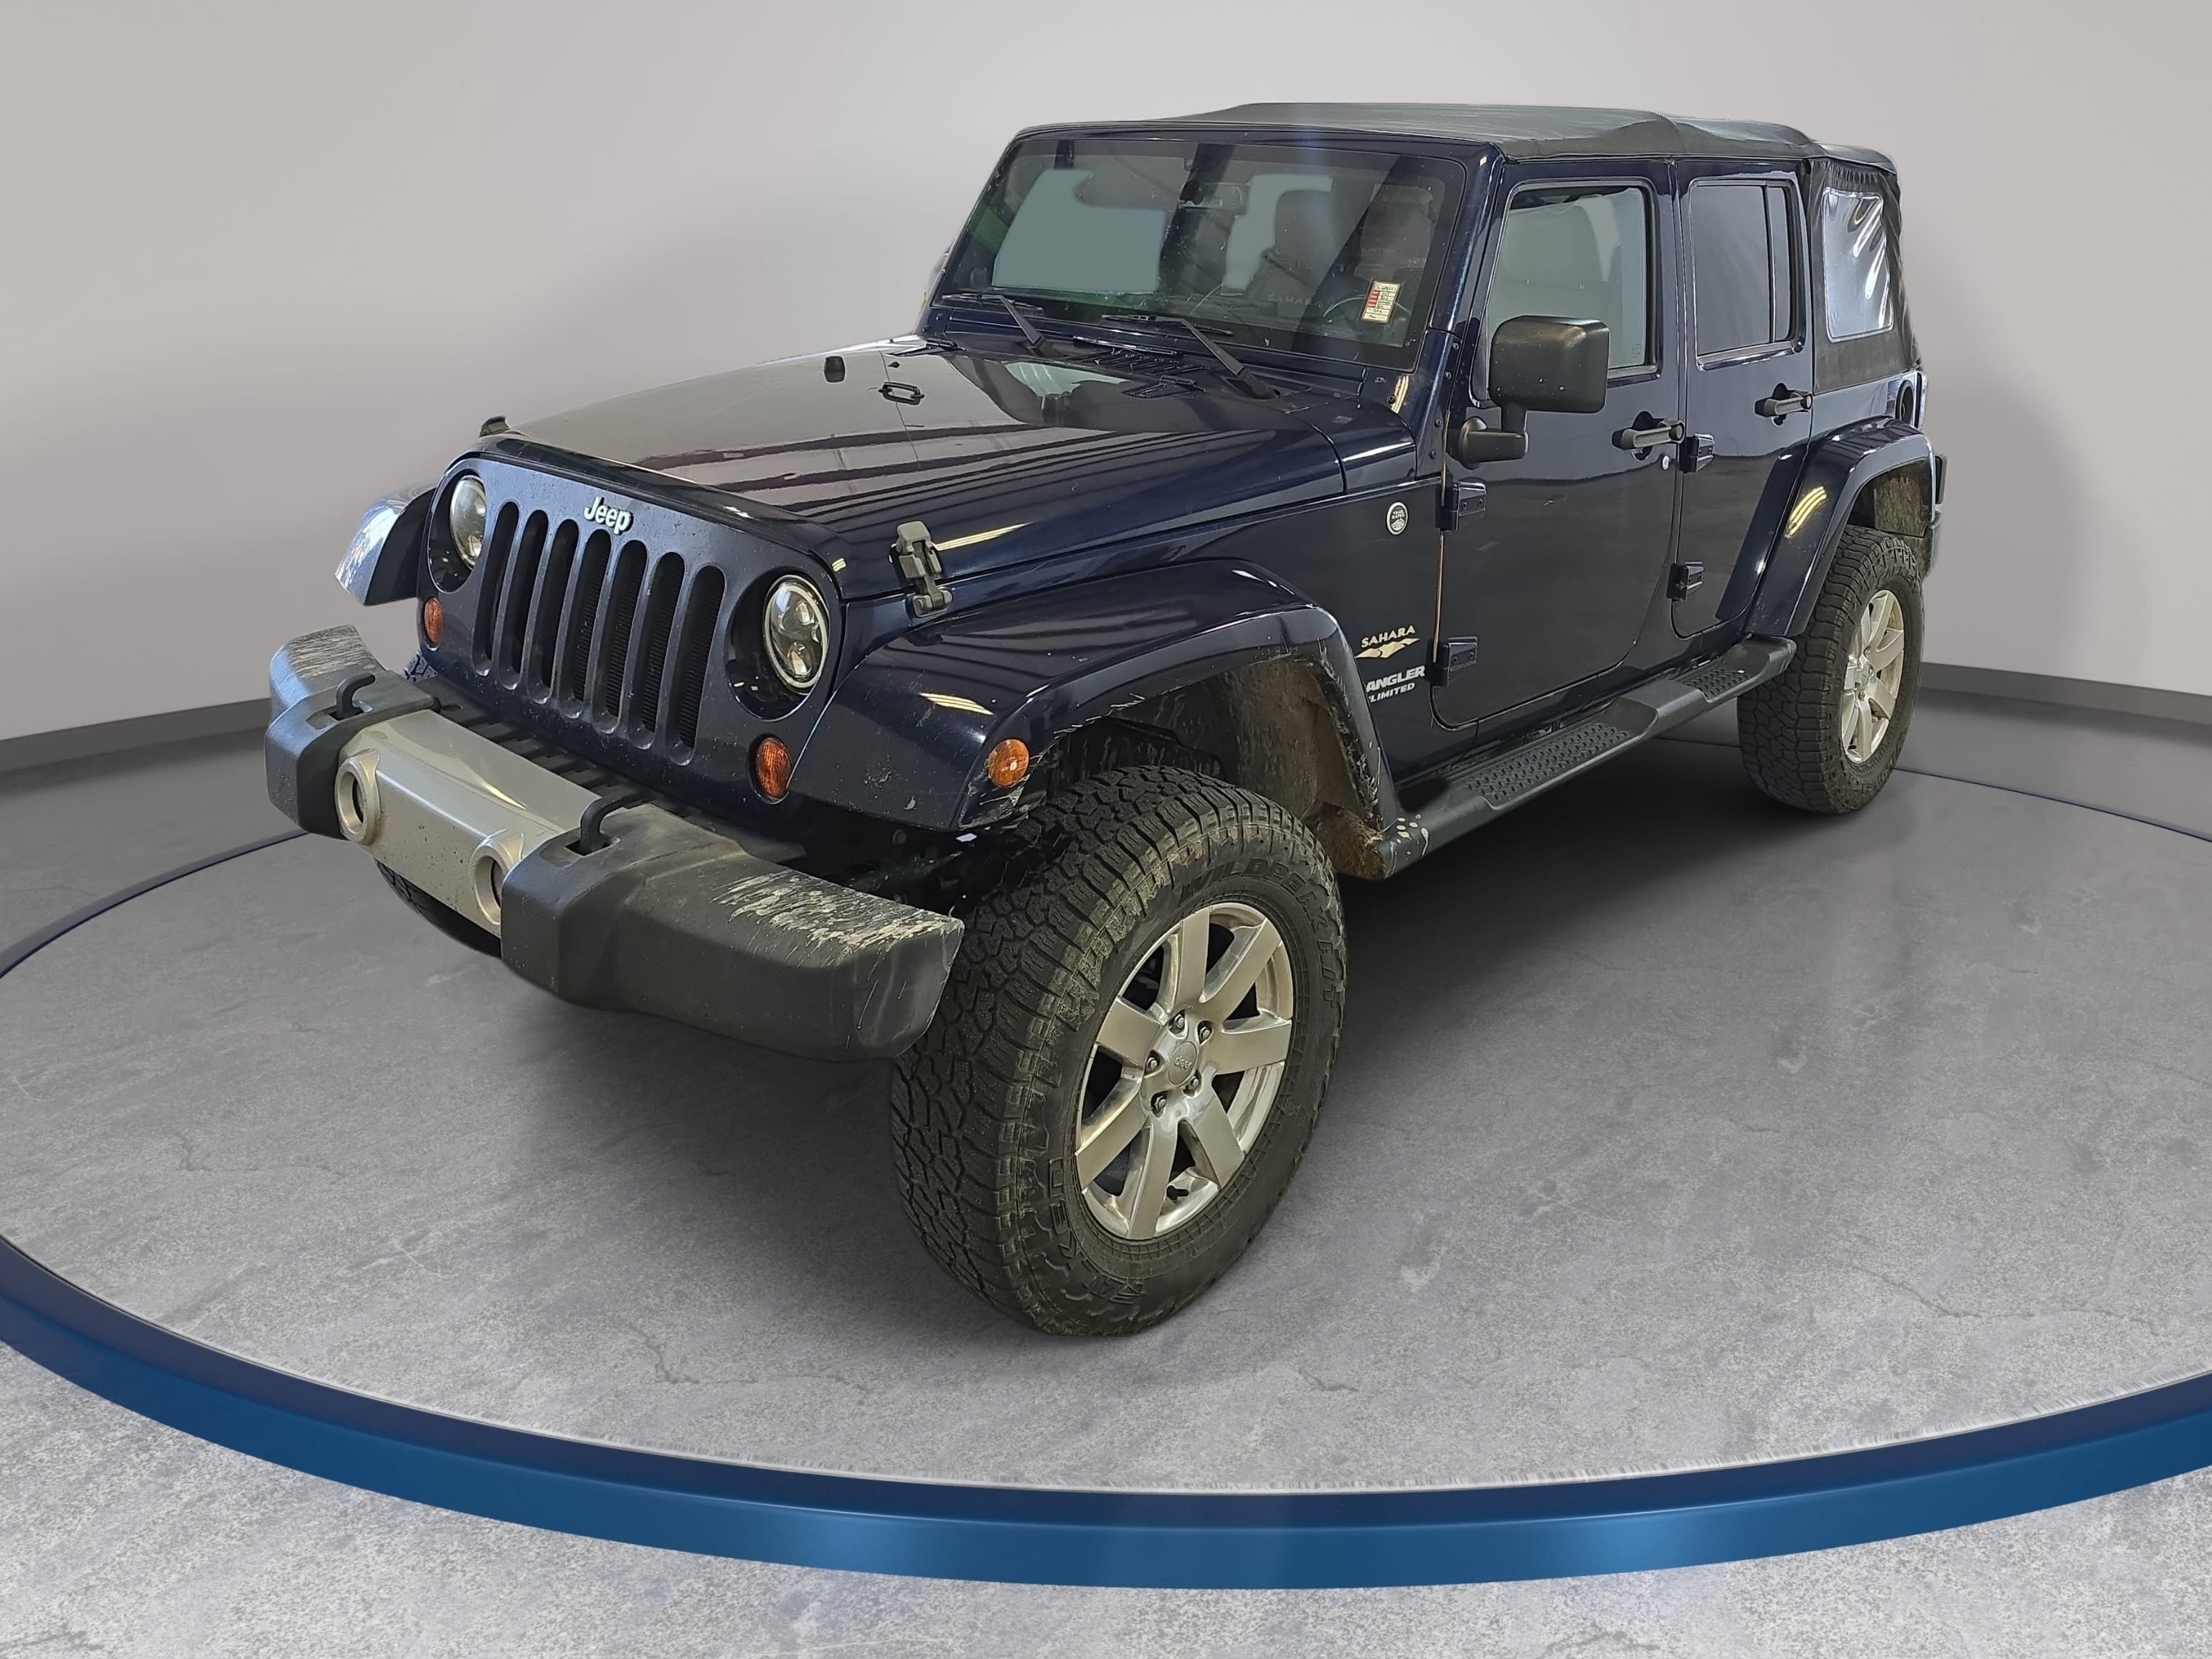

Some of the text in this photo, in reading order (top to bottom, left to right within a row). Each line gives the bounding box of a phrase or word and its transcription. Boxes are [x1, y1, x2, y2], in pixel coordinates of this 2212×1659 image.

[583, 496, 634, 536] Jeep
[1361, 625, 1416, 648] SAHARA
[1365, 665, 1426, 693] ANGLER
[1369, 682, 1416, 703] LIMITED
[1178, 857, 1329, 931] WILDPEAK
